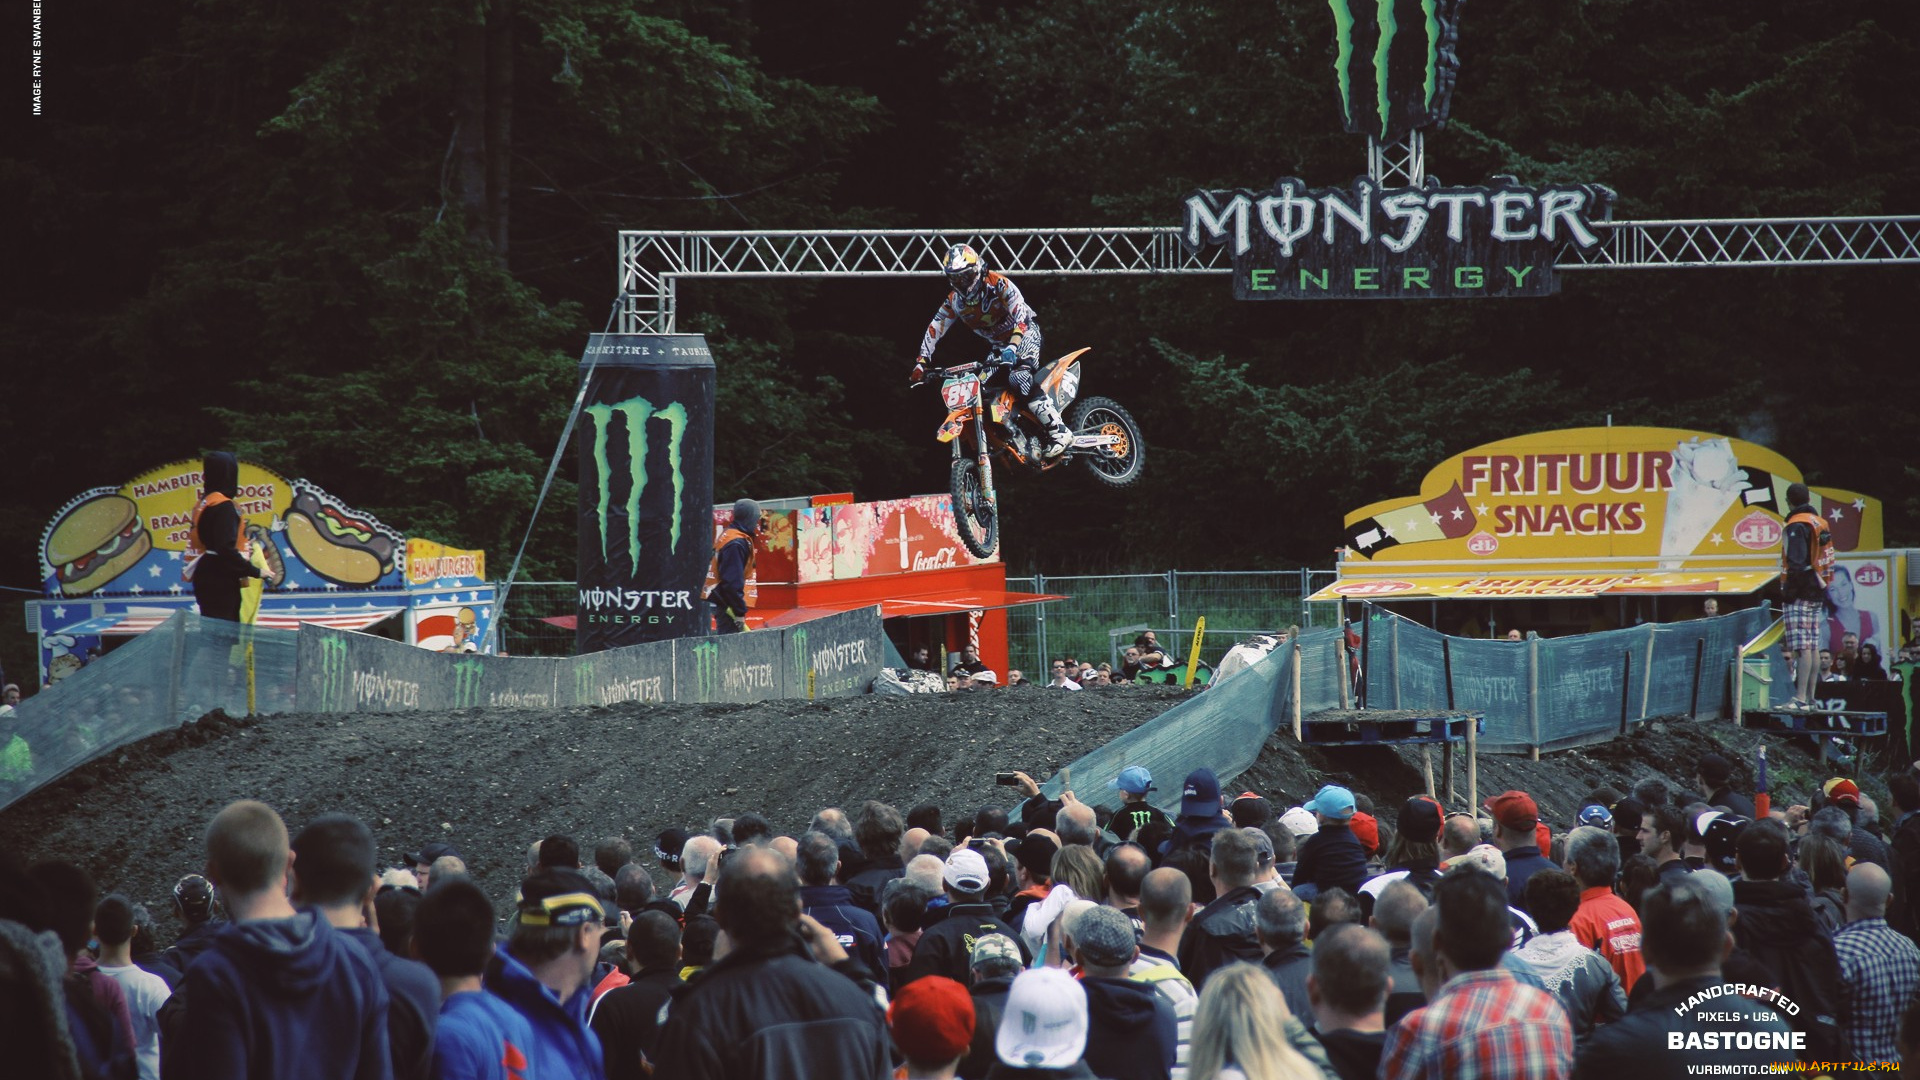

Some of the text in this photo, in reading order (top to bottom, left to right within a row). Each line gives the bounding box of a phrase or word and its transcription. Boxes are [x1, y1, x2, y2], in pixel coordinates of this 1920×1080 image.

[1252, 266, 1534, 290] ENERGY
[947, 381, 977, 407] 84
[1462, 451, 1676, 496] FRITUUR
[1494, 502, 1646, 537] SNACKS
[414, 556, 475, 580] HAMBURGERS
[589, 614, 675, 624] ENERGY
[822, 675, 860, 696] ENERGY
